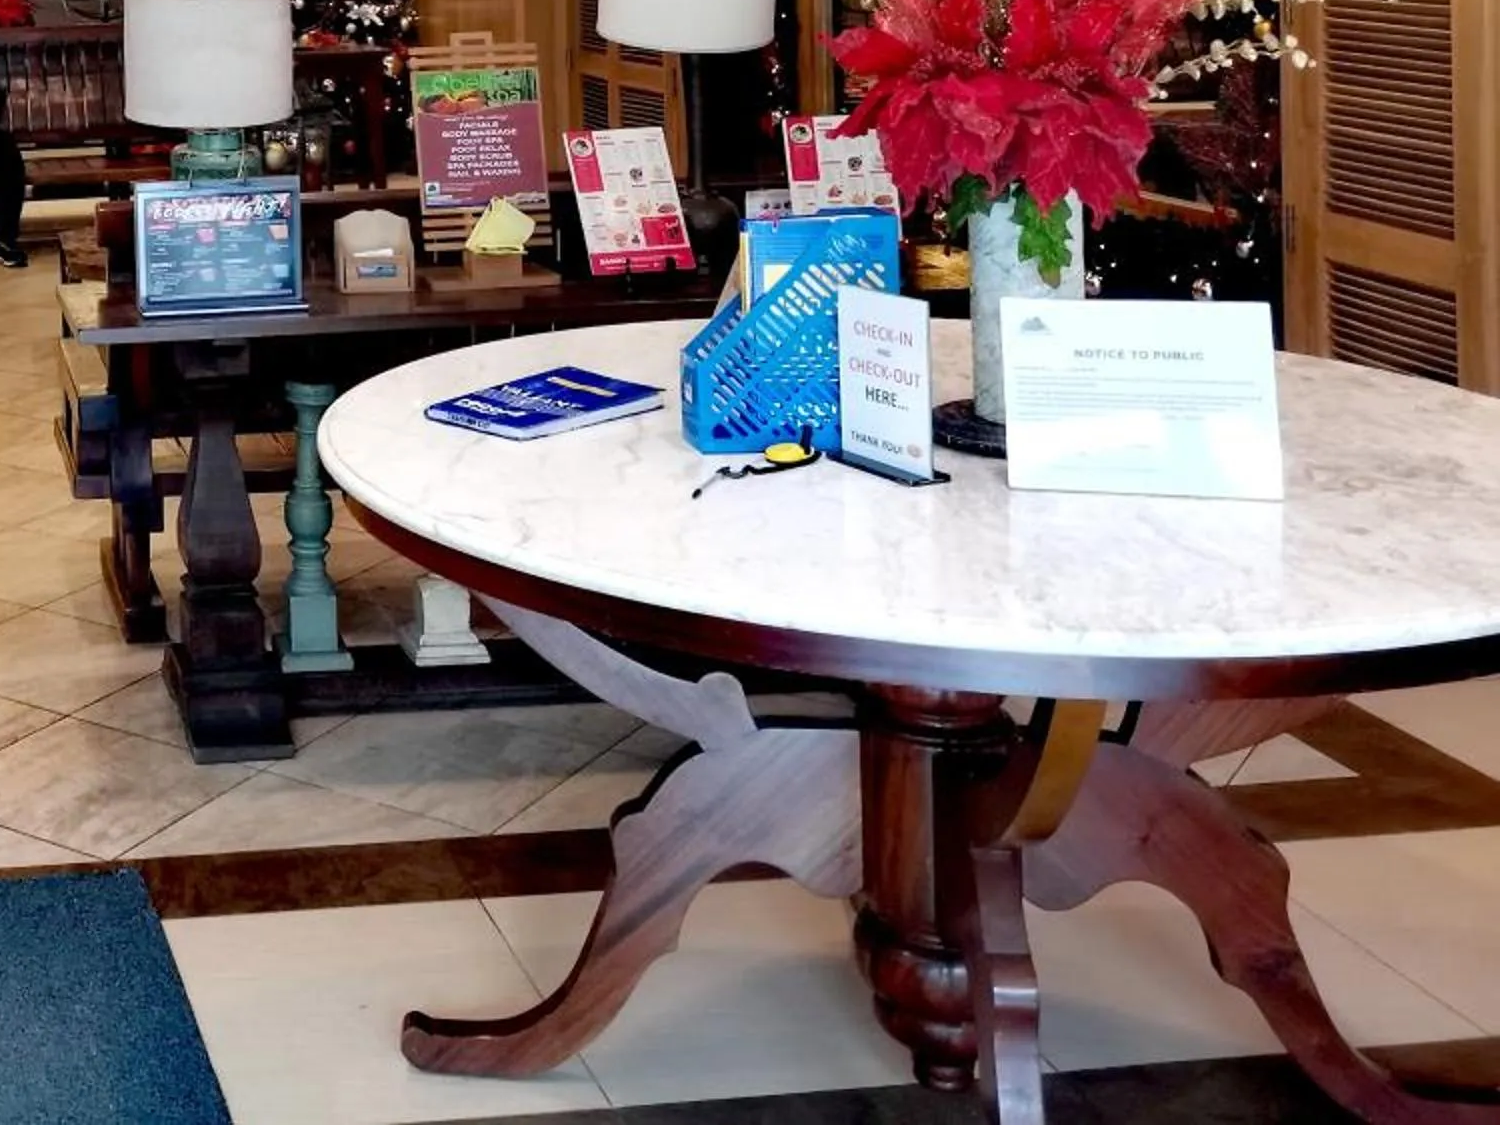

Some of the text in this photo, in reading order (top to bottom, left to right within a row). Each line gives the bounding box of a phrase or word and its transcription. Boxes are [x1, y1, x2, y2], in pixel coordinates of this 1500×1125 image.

[441, 128, 517, 138] BODY MASSAGE
[451, 144, 511, 154] FOOT RELAX
[449, 152, 513, 162] BODY SCRUB
[447, 160, 519, 171] SPA PACKAGES
[853, 320, 913, 347] CHECK-IN
[1073, 348, 1204, 361] NOTICE TO PUBLIC
[848, 357, 921, 388] CHECK-OUT
[850, 430, 878, 448] THANK
